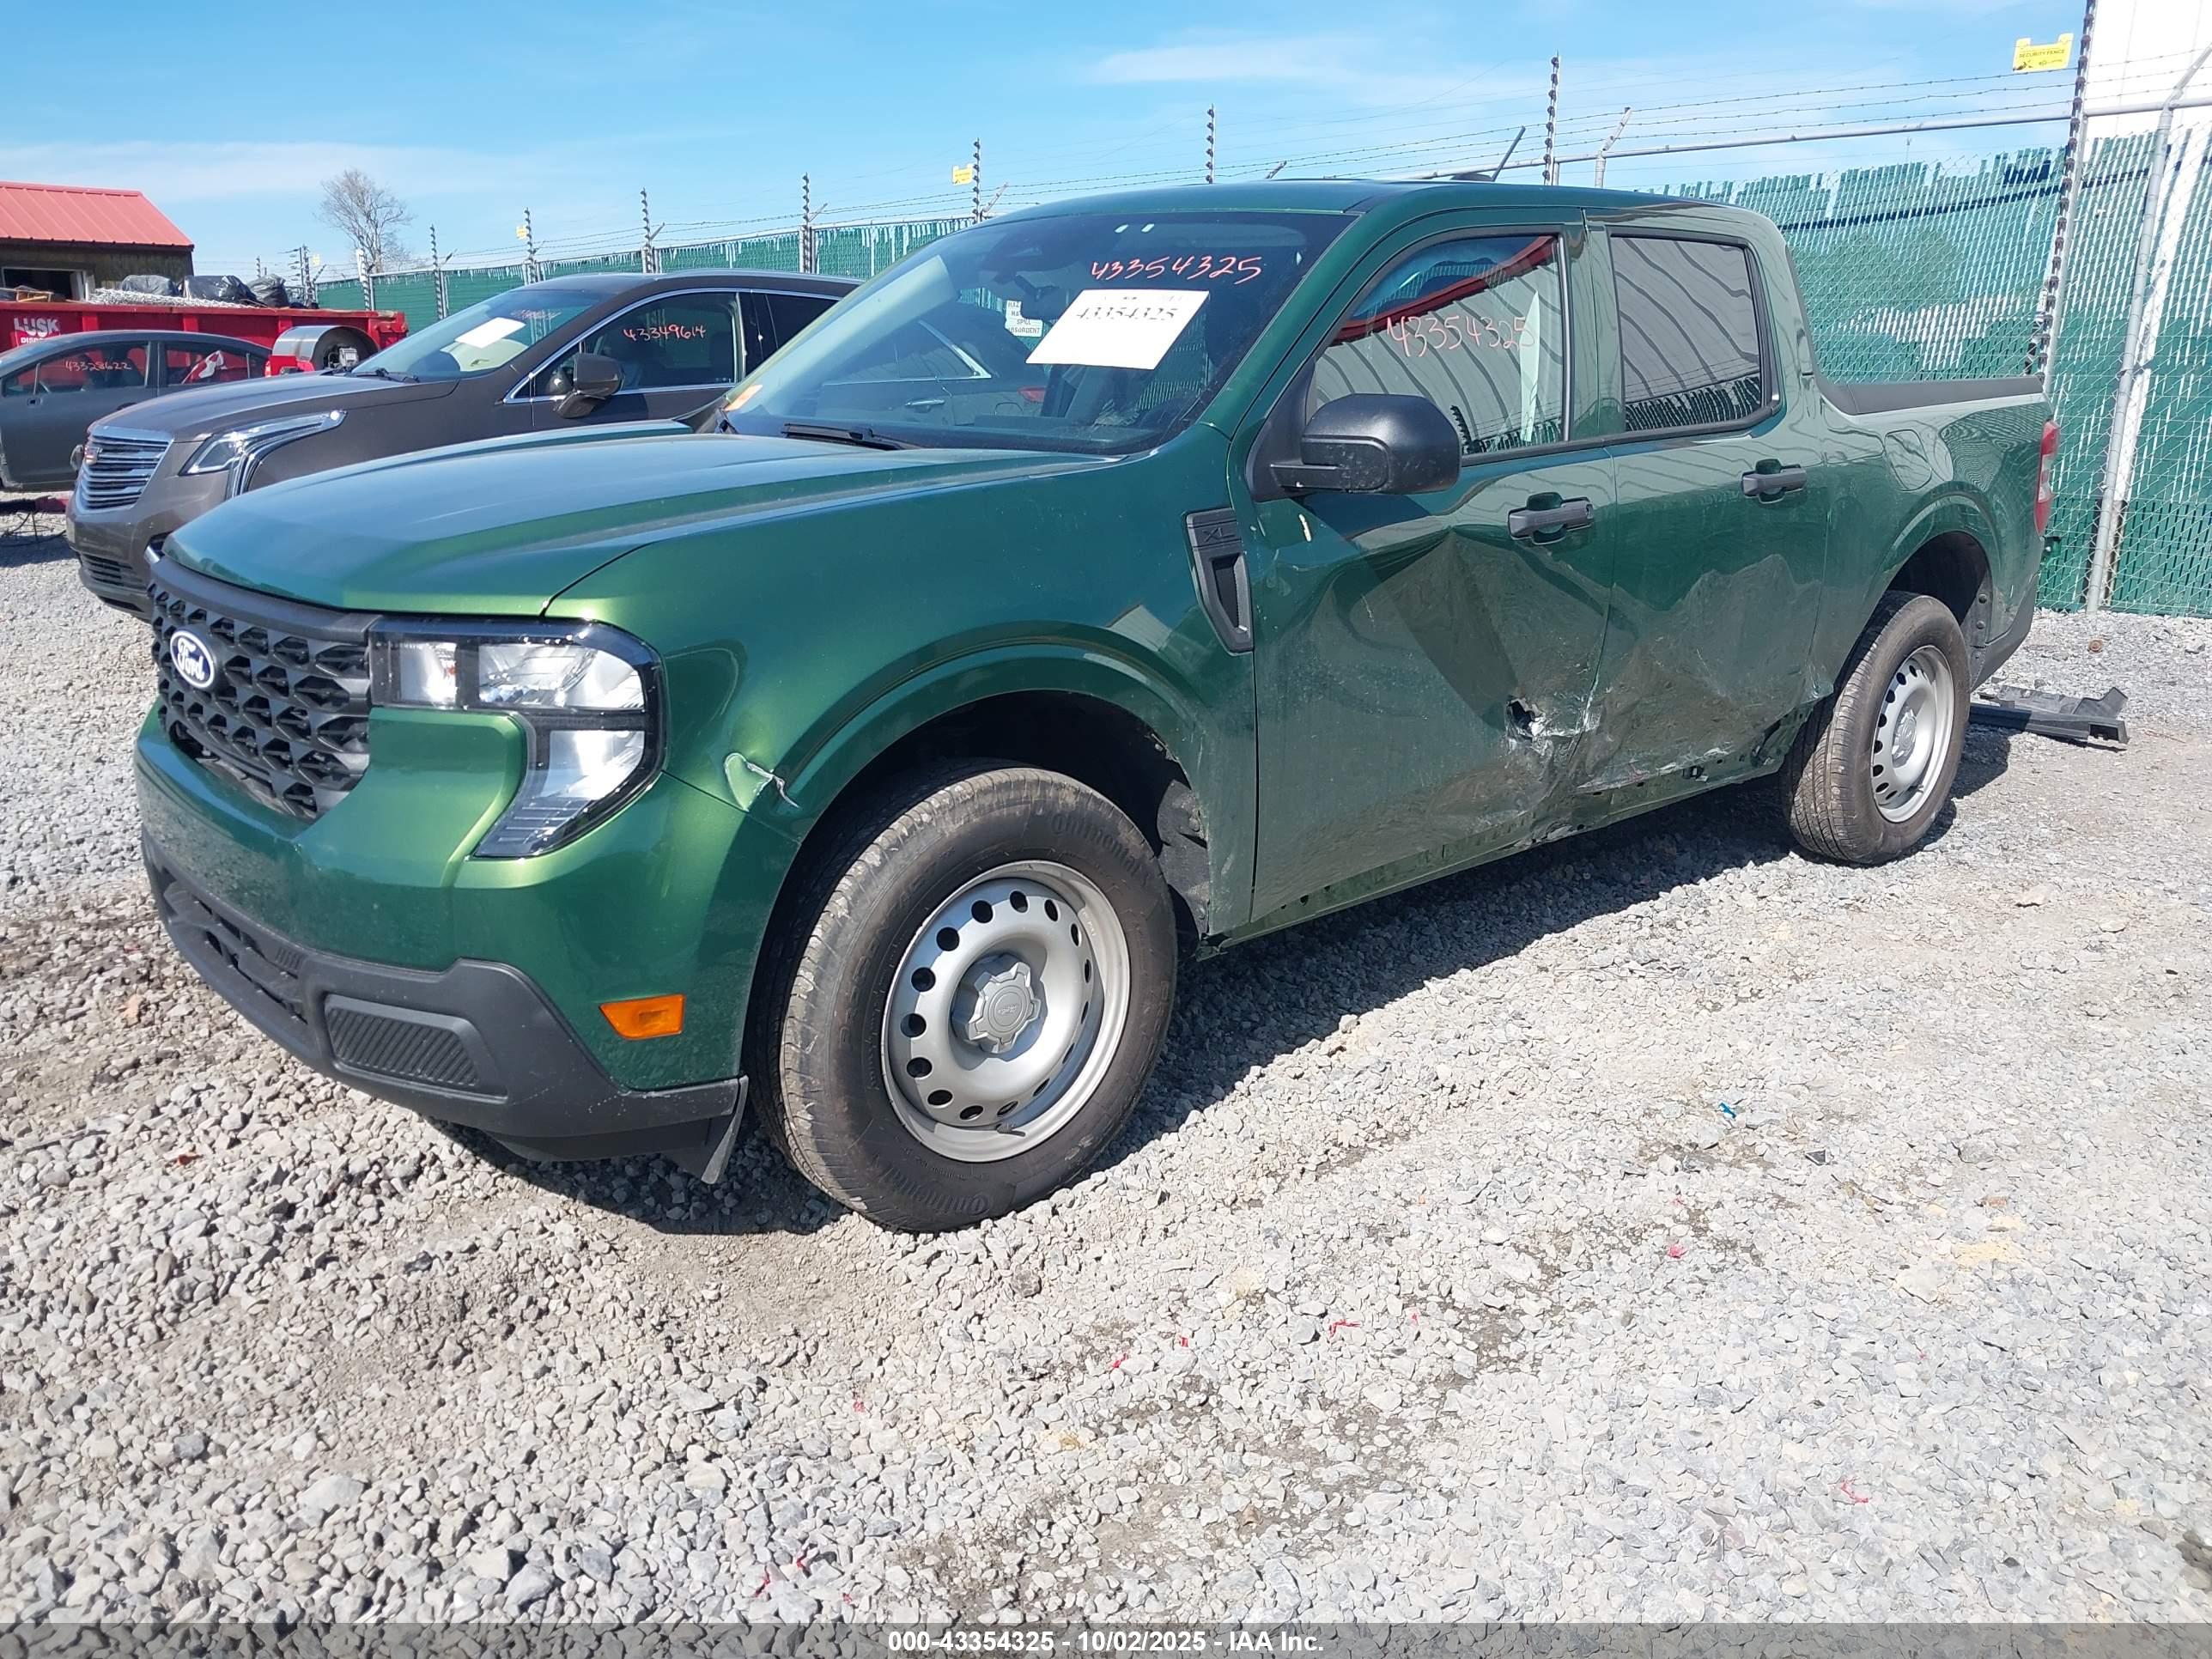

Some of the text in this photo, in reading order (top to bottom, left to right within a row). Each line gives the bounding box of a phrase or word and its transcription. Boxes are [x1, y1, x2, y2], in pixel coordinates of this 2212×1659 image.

[1091, 256, 1261, 284] 43354325
[14, 317, 60, 337] LUSK
[623, 325, 706, 341] 43349614
[1387, 315, 1534, 357] 43354325
[1203, 526, 1236, 543] XL
[178, 637, 205, 681] Ford
